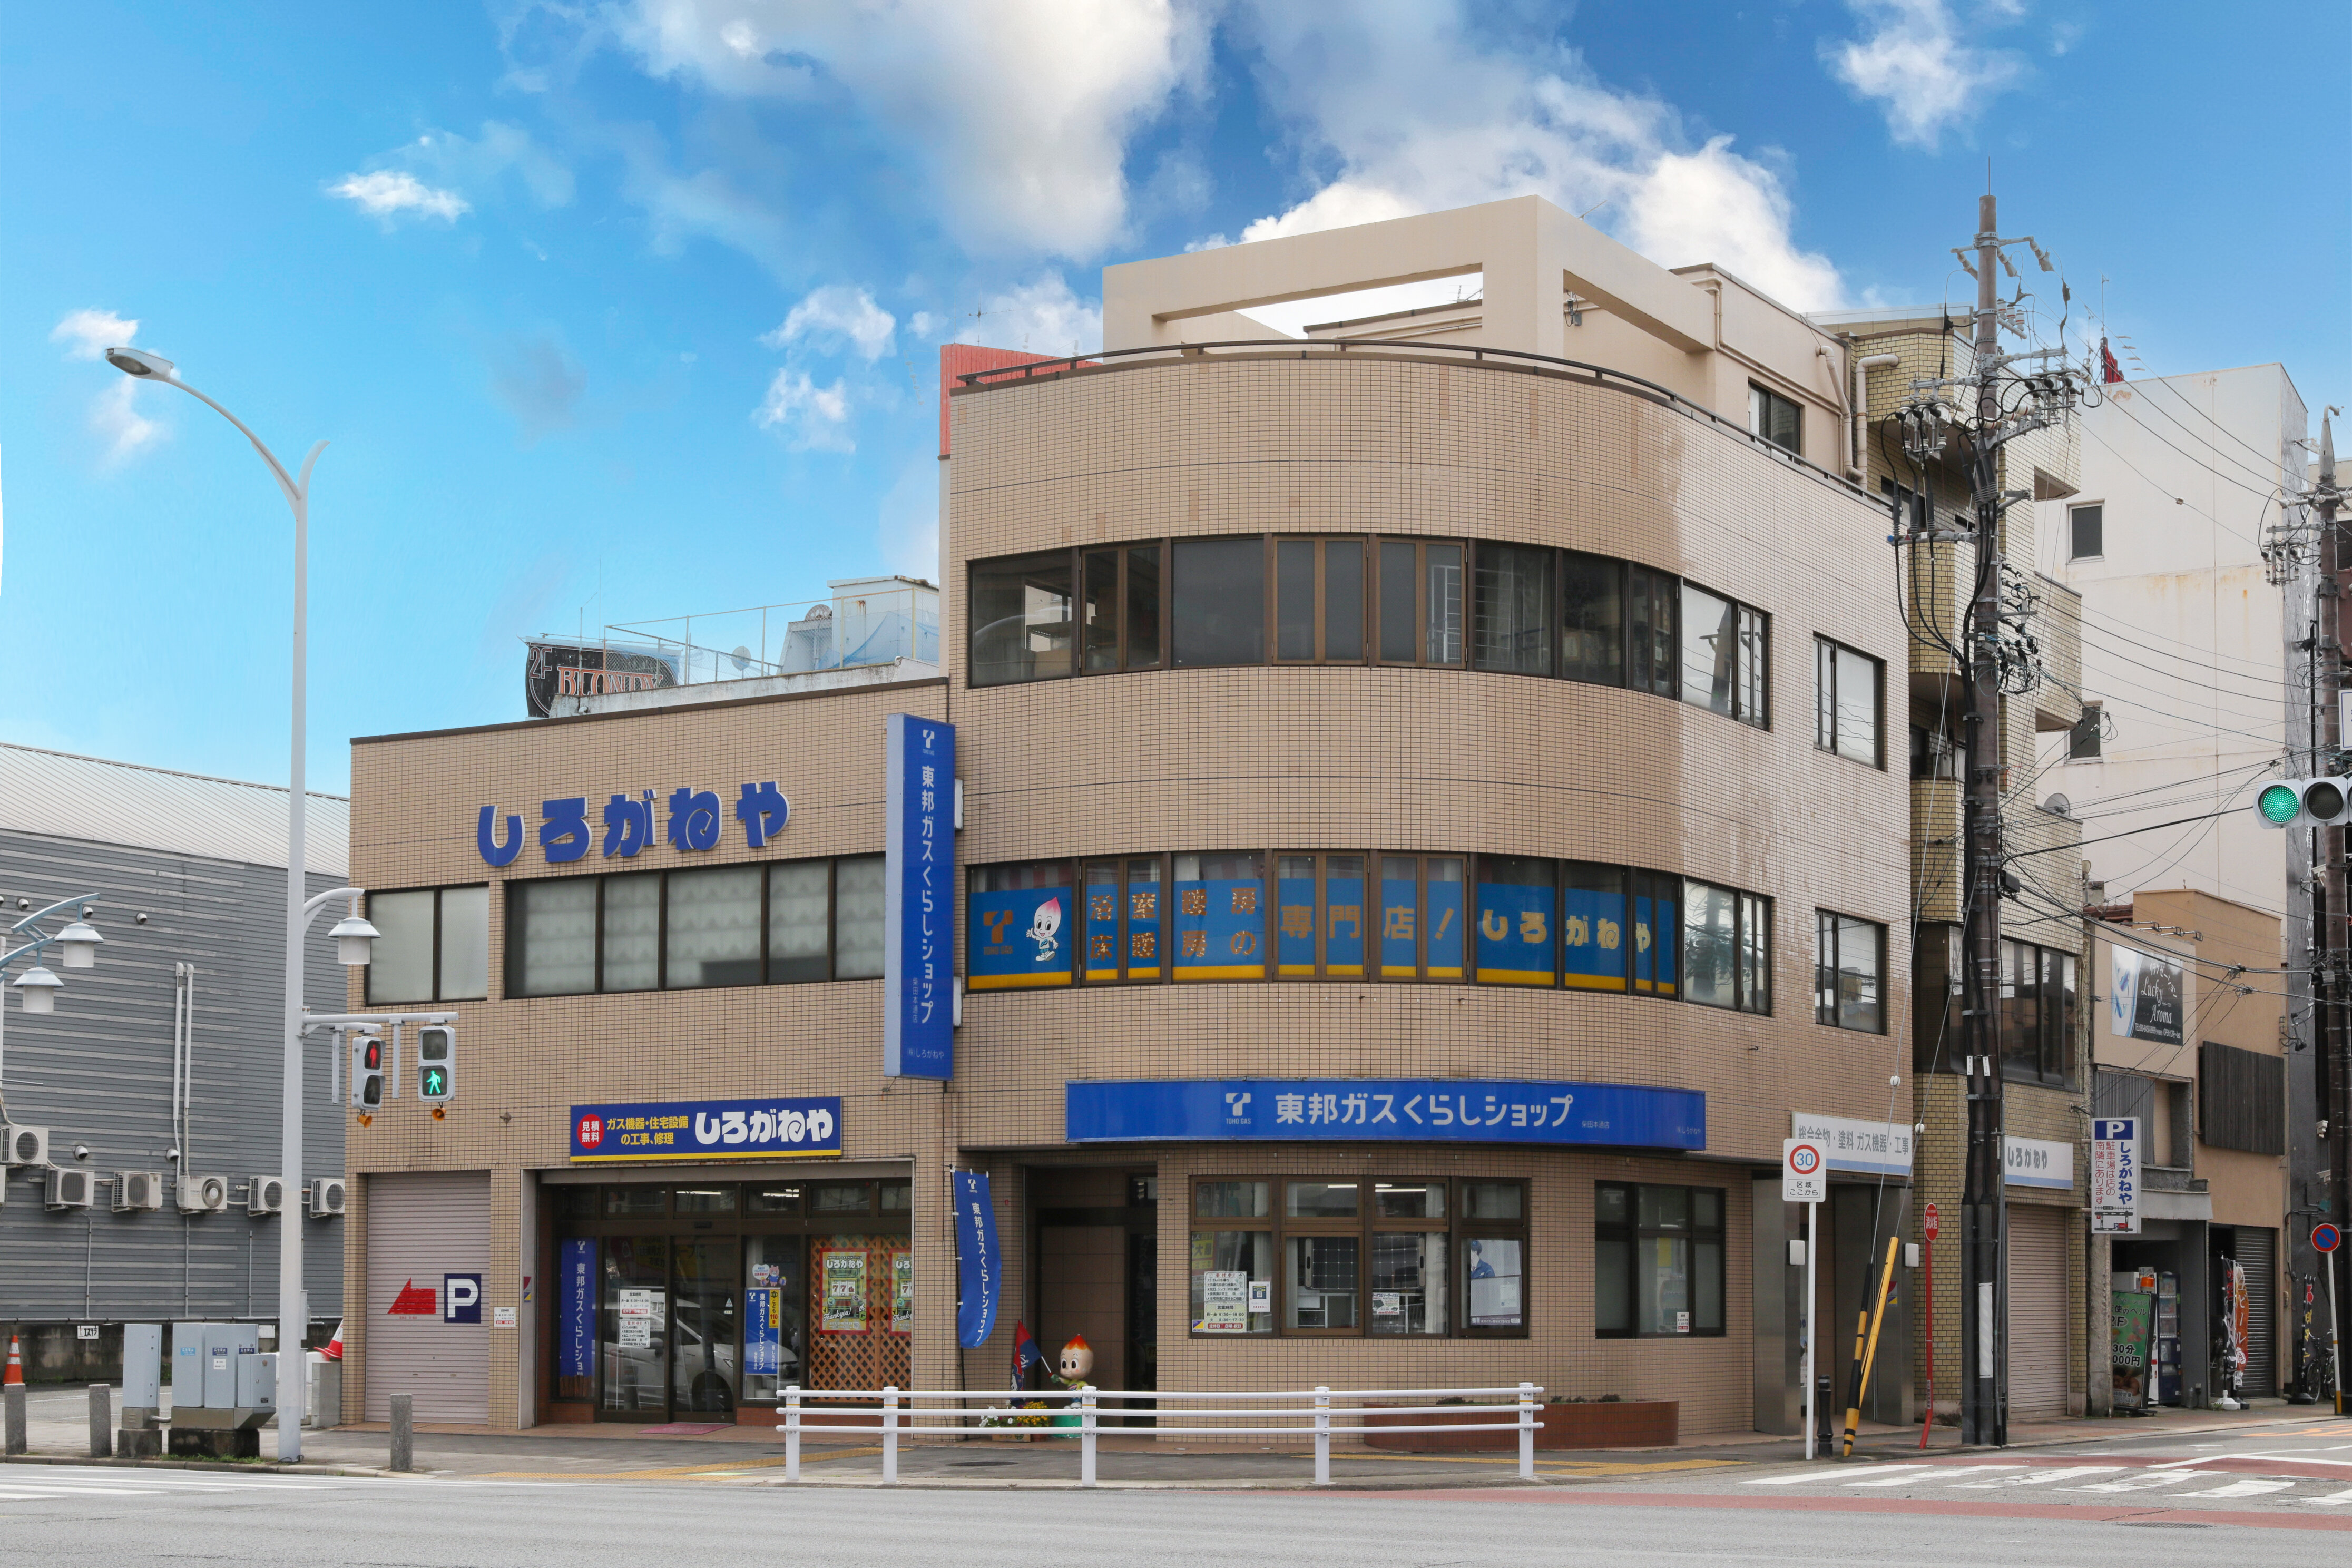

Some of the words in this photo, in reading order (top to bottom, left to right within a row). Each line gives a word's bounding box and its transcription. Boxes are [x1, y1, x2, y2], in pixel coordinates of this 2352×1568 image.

[529, 647, 552, 679] 2F
[477, 781, 790, 867] しろがねや
[922, 766, 935, 1023] 東邦ガスくらしショップ
[1482, 909, 1651, 953] しろがねや
[2141, 976, 2162, 1007] Lucky
[2150, 1004, 2172, 1024] Aroma
[582, 1121, 600, 1132] 見積
[695, 1109, 834, 1145] しろがねや
[1275, 1092, 1573, 1128] 東邦ガスくらしショップ
[582, 1132, 600, 1142] 無料
[2106, 1121, 2125, 1139] P
[1796, 1153, 1814, 1166] 30
[2007, 1146, 2047, 1169] しろがねや
[2095, 1141, 2104, 1204] 南隣にあります
[2106, 1141, 2115, 1196] 駐車場は店の
[2118, 1142, 2133, 1205] しろがねや
[1926, 1216, 1937, 1229] 消火栓
[826, 1260, 863, 1268] しろがねや
[972, 1202, 989, 1342] 東邦ガスくらしショップ
[447, 1279, 478, 1318] P
